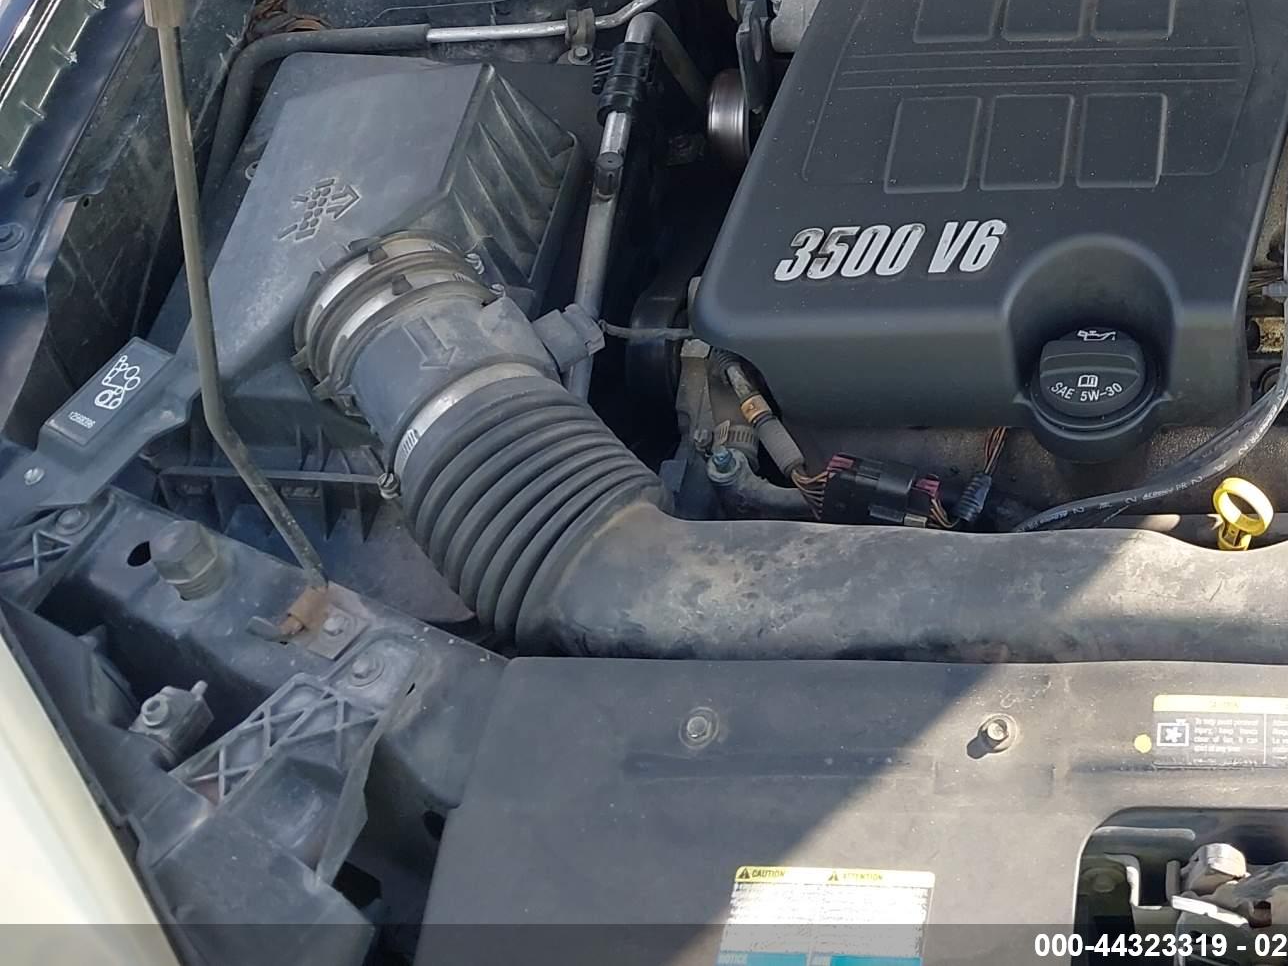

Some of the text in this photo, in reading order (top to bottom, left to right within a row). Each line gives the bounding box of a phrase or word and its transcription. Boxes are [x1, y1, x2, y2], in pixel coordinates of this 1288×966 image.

[774, 219, 1008, 282] 3500 V6
[1051, 381, 1123, 402] SAE 5W-30
[752, 869, 786, 878] CAUTION
